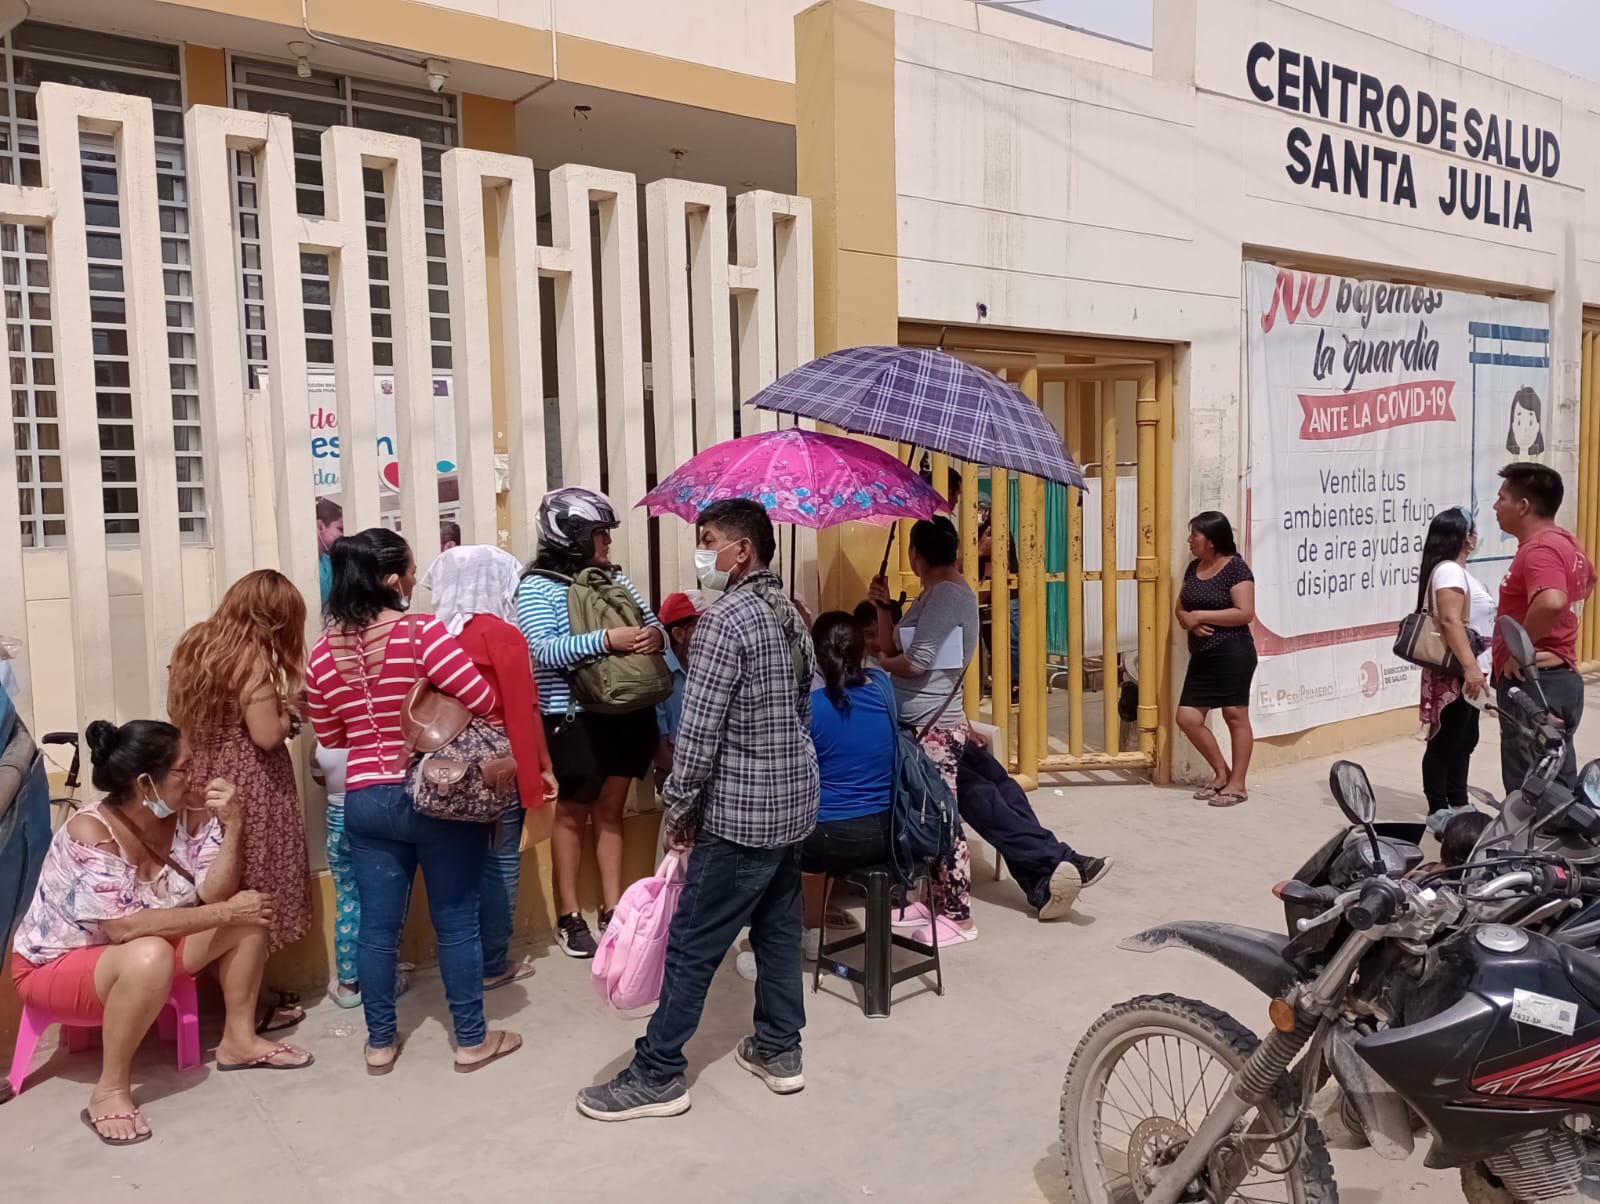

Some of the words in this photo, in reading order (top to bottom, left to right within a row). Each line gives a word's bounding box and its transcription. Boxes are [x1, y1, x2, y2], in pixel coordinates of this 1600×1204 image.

[1246, 41, 1411, 138] CENTRO
[1416, 90, 1457, 153] DE
[1463, 107, 1561, 178] SALUD
[1285, 126, 1418, 209] SANTA
[1438, 165, 1533, 233] JULIA
[1336, 278, 1443, 329] bajemos
[1313, 327, 1336, 381] la
[1342, 319, 1440, 393] guardia
[1309, 406, 1349, 433] ANTE
[1353, 402, 1372, 429] LA
[1376, 386, 1447, 424] COVID-19
[1319, 466, 1376, 494] Ventila
[1381, 469, 1406, 492] tus
[1283, 502, 1378, 530] ambientes.
[1382, 499, 1396, 524] El
[1402, 498, 1435, 527] flujo
[1297, 537, 1318, 563] de
[1324, 535, 1356, 561] aire
[1362, 531, 1409, 562] ayuda
[1413, 534, 1423, 552] a
[1296, 569, 1356, 600] disipar
[1361, 564, 1375, 590] el
[1380, 563, 1420, 587] virus
